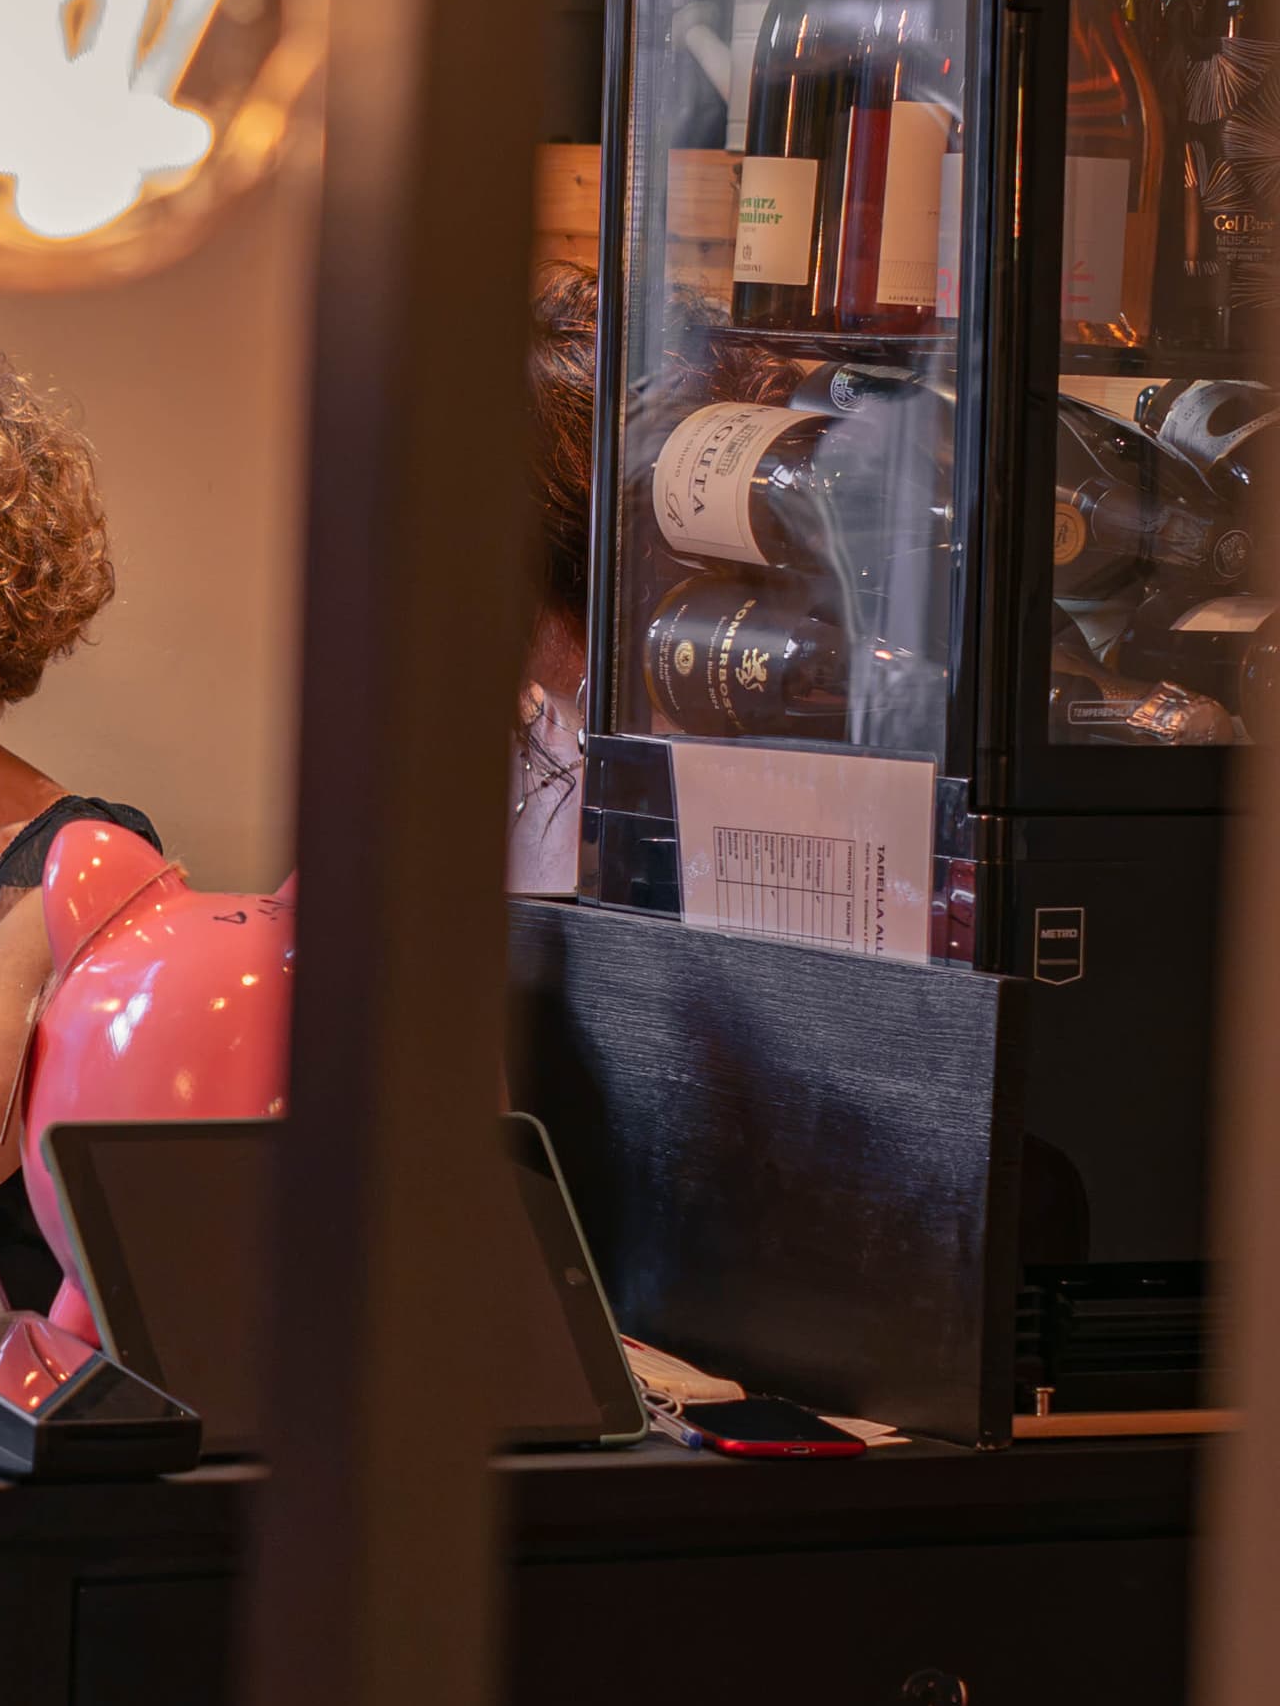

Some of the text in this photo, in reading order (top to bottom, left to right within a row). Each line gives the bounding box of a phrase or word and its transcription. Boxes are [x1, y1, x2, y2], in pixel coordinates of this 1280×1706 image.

[1213, 214, 1239, 232] Col
[706, 660, 715, 685] Blanc
[876, 845, 886, 919] TABELLA
[1040, 928, 1078, 939] METRO
